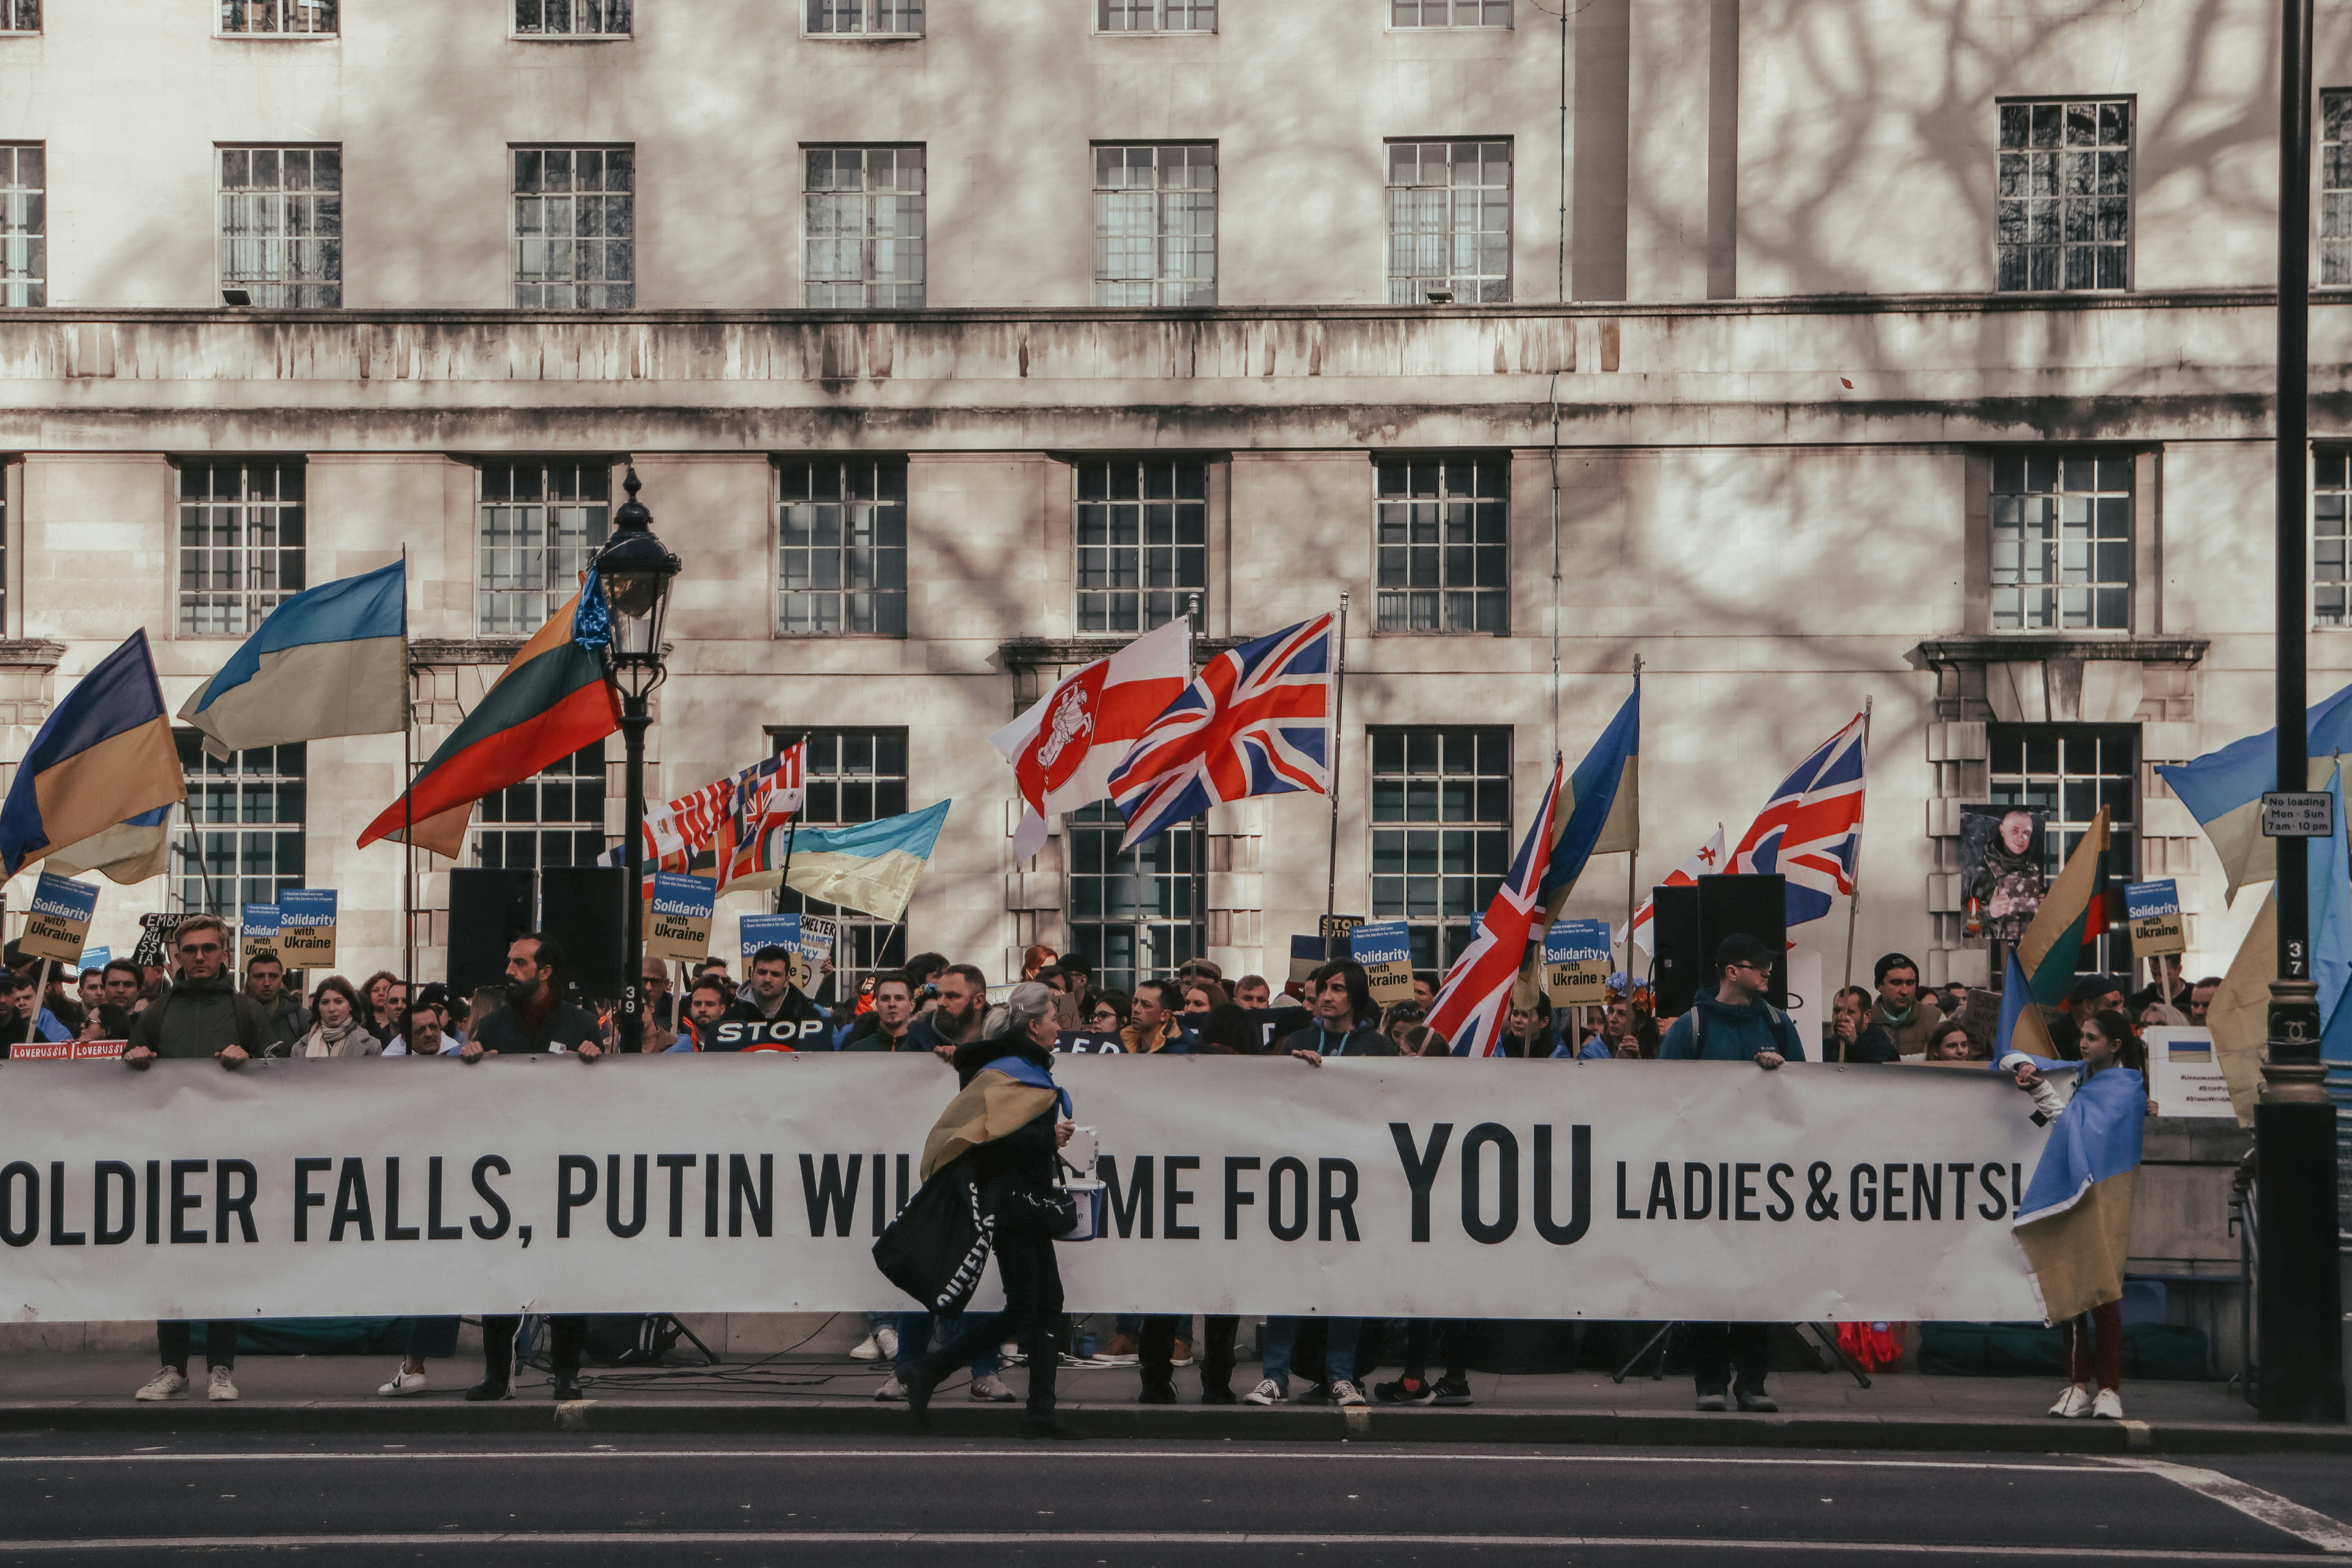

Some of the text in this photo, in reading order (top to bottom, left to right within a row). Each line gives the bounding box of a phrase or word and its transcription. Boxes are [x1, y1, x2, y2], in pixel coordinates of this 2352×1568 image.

[2269, 797, 2325, 807] No loading
[2304, 809, 2324, 818] Sun
[33, 898, 92, 923] Solidarity
[653, 898, 712, 919] Solidarity
[2129, 902, 2178, 918] Solidarity
[44, 915, 66, 927] with
[281, 913, 336, 927] Solidarity
[666, 915, 688, 926] with
[800, 916, 836, 936] SHELTER
[1322, 918, 1363, 930] STOP
[2143, 916, 2161, 926] with
[31, 921, 81, 944] Ukraine
[244, 924, 279, 936] Solidari
[294, 927, 314, 935] with
[655, 923, 705, 942] Ukraine
[2136, 924, 2178, 939] Ukraine
[143, 931, 160, 943] RU
[284, 936, 331, 948] Ukraine
[800, 933, 834, 950] KRAINE'S
[139, 941, 157, 954] SS
[245, 945, 278, 956] Ukrain
[1548, 947, 1599, 961] Solidarity
[801, 947, 818, 962] SKY
[1354, 948, 1409, 963] Solidarity
[1368, 963, 1389, 974] with
[1561, 962, 1580, 972] with
[1368, 973, 1408, 987] kraine
[1553, 972, 1597, 986] Ukraine
[717, 1020, 823, 1042] STOP
[14, 1047, 67, 1058] LOVERUSSIA
[76, 1044, 126, 1056] LOVERUSSI
[0, 1159, 260, 1247] OLDIER
[294, 1154, 533, 1249] FALLS,
[557, 1153, 773, 1239] PUTIN
[1224, 1156, 1361, 1242] FOR
[1388, 1122, 1592, 1245] YOU
